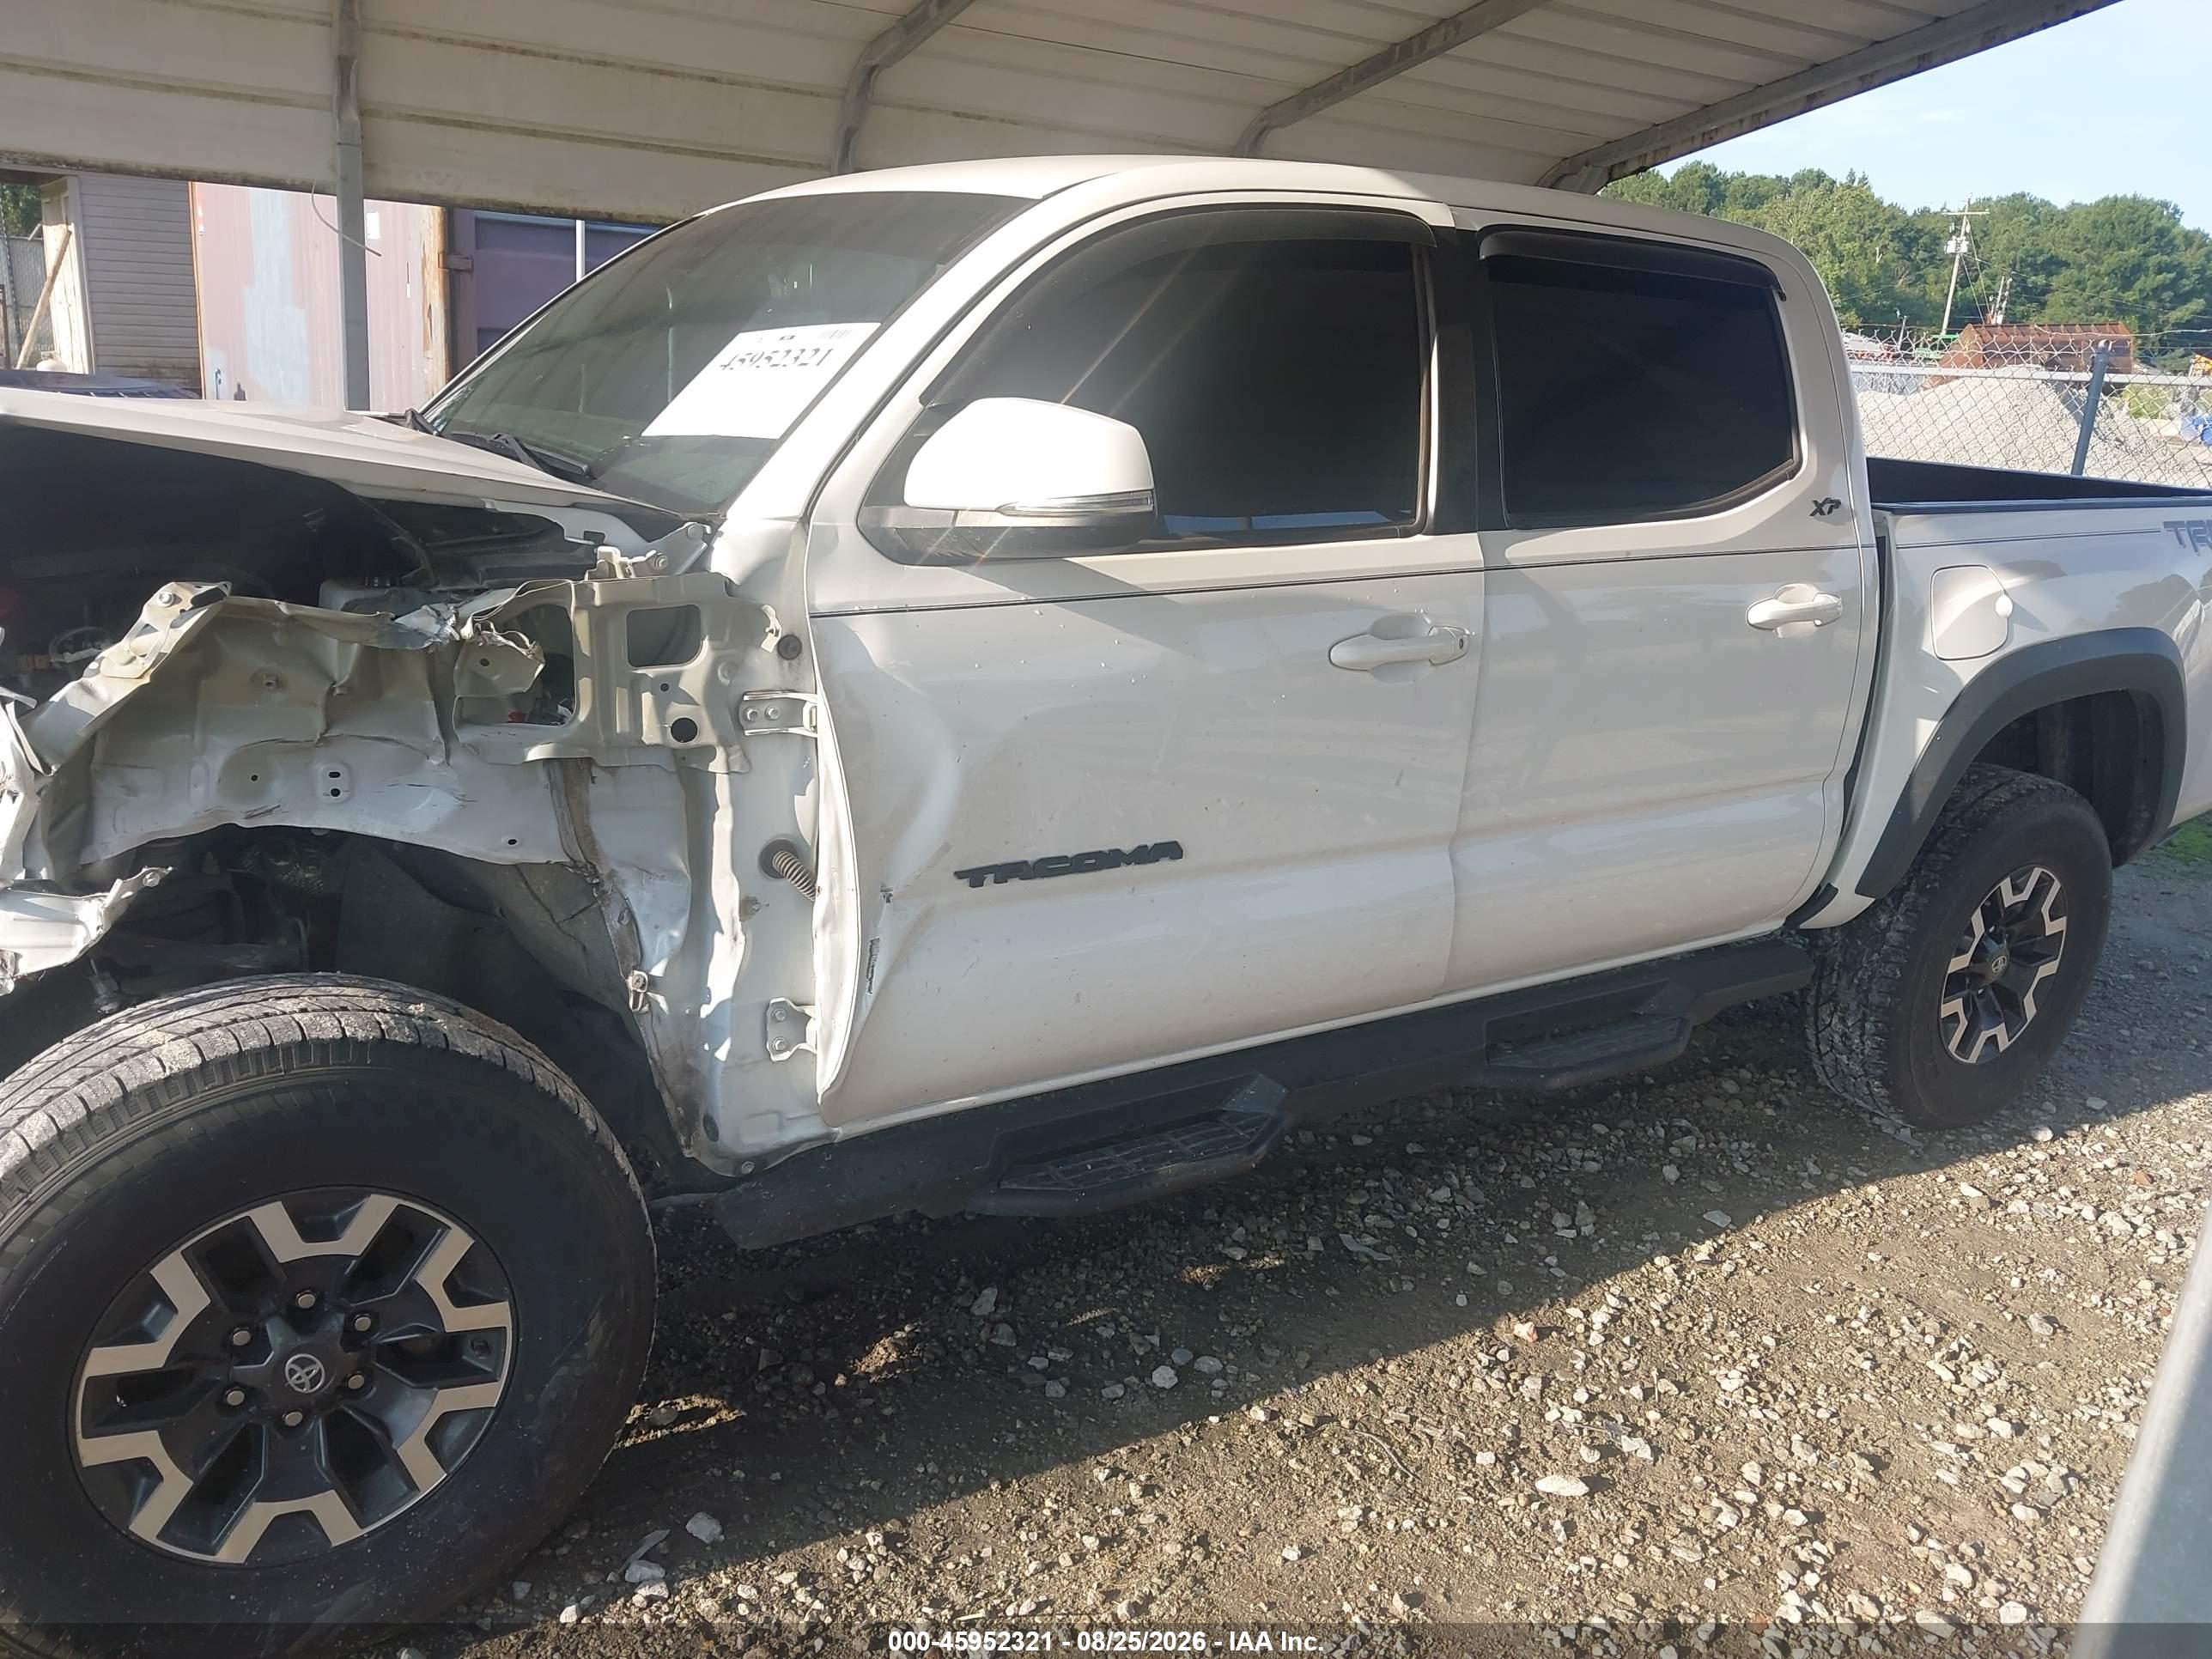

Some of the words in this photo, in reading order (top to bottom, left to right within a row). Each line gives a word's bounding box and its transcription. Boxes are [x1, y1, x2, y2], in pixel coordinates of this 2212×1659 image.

[1809, 497, 1841, 516] XP
[2163, 520, 2212, 557] TR
[953, 841, 1183, 888] TACOMA
